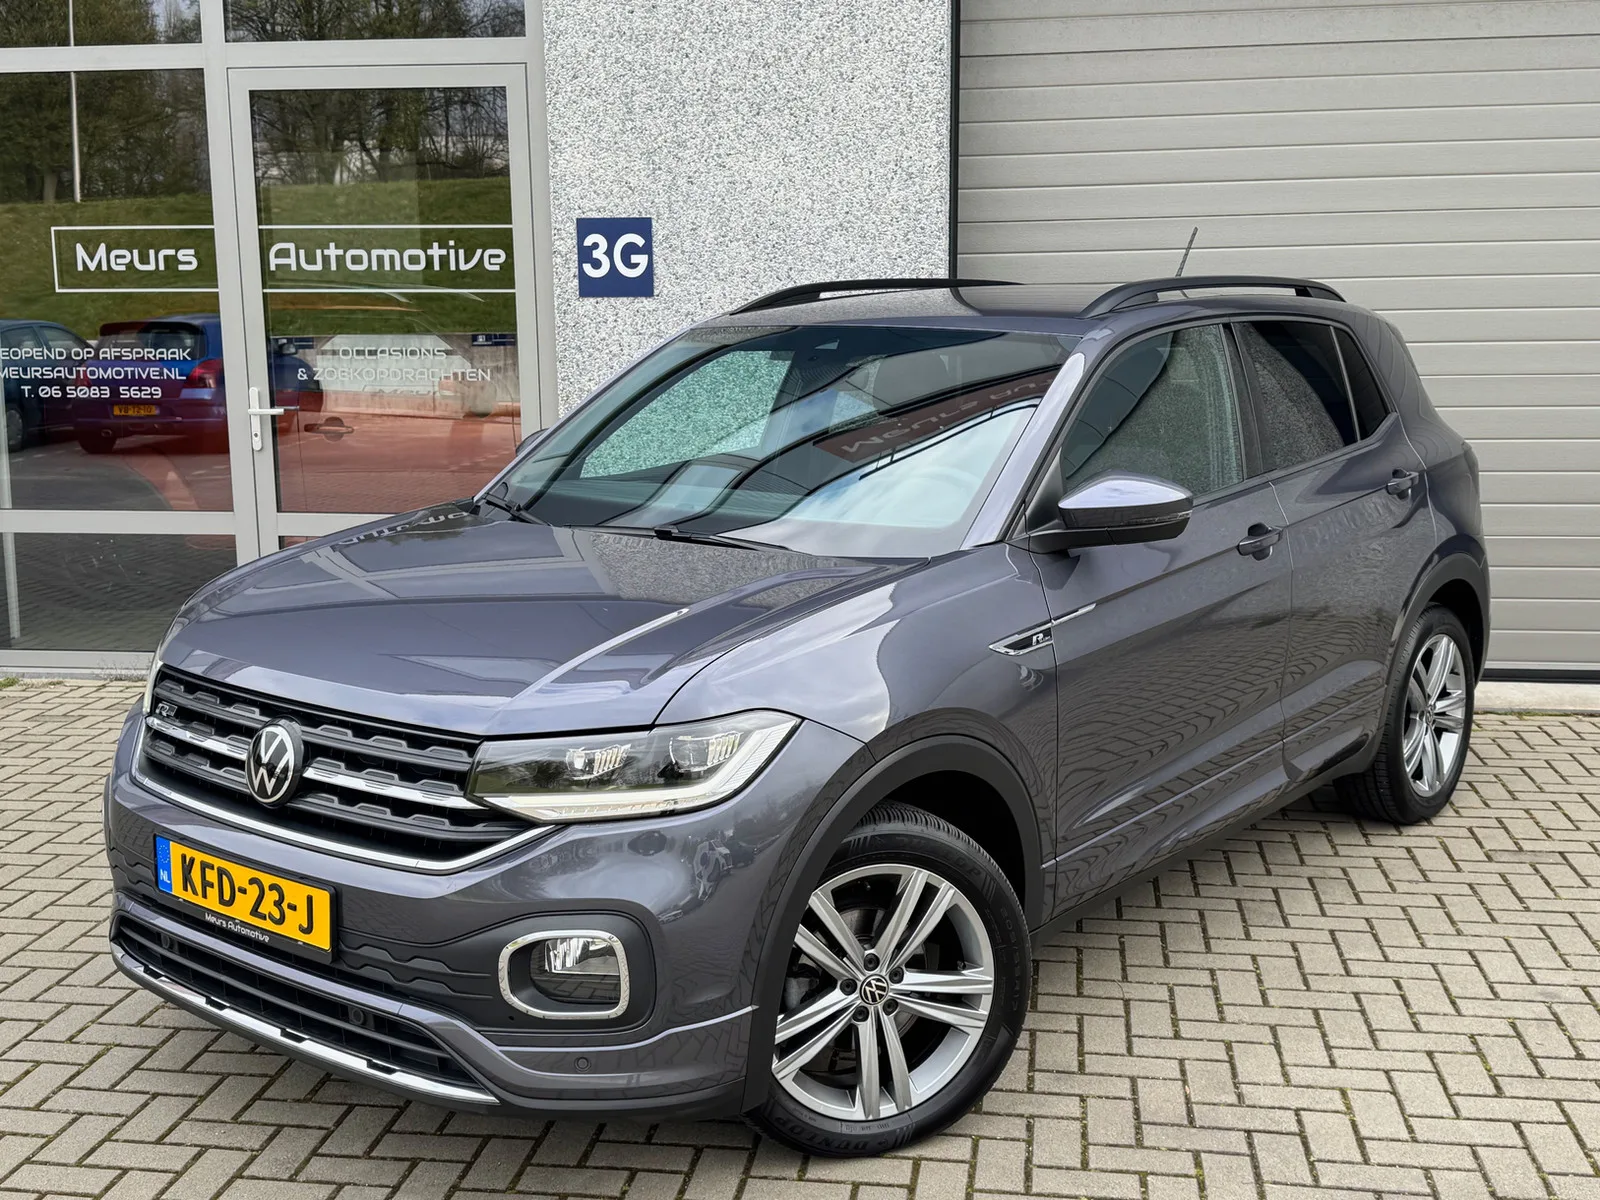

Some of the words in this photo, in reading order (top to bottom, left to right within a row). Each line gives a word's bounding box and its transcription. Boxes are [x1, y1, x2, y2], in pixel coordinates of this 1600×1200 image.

[75, 242, 199, 272] Meurs
[268, 239, 507, 272] Automotive
[582, 232, 650, 280] 3G
[71, 348, 95, 361] OP
[99, 347, 192, 361] AFSPRAAK
[339, 346, 447, 360] OCCASIONS
[297, 367, 308, 381] &
[313, 367, 491, 382] ZOEKOPDRACHTEN
[21, 385, 35, 399] T.
[38, 386, 61, 398] 06
[66, 386, 110, 398] 5083
[119, 386, 162, 399] 5629
[160, 869, 171, 884] NL
[181, 853, 314, 935] KFD-23-J
[205, 912, 227, 928] Meurs
[228, 921, 270, 943] Automotive
